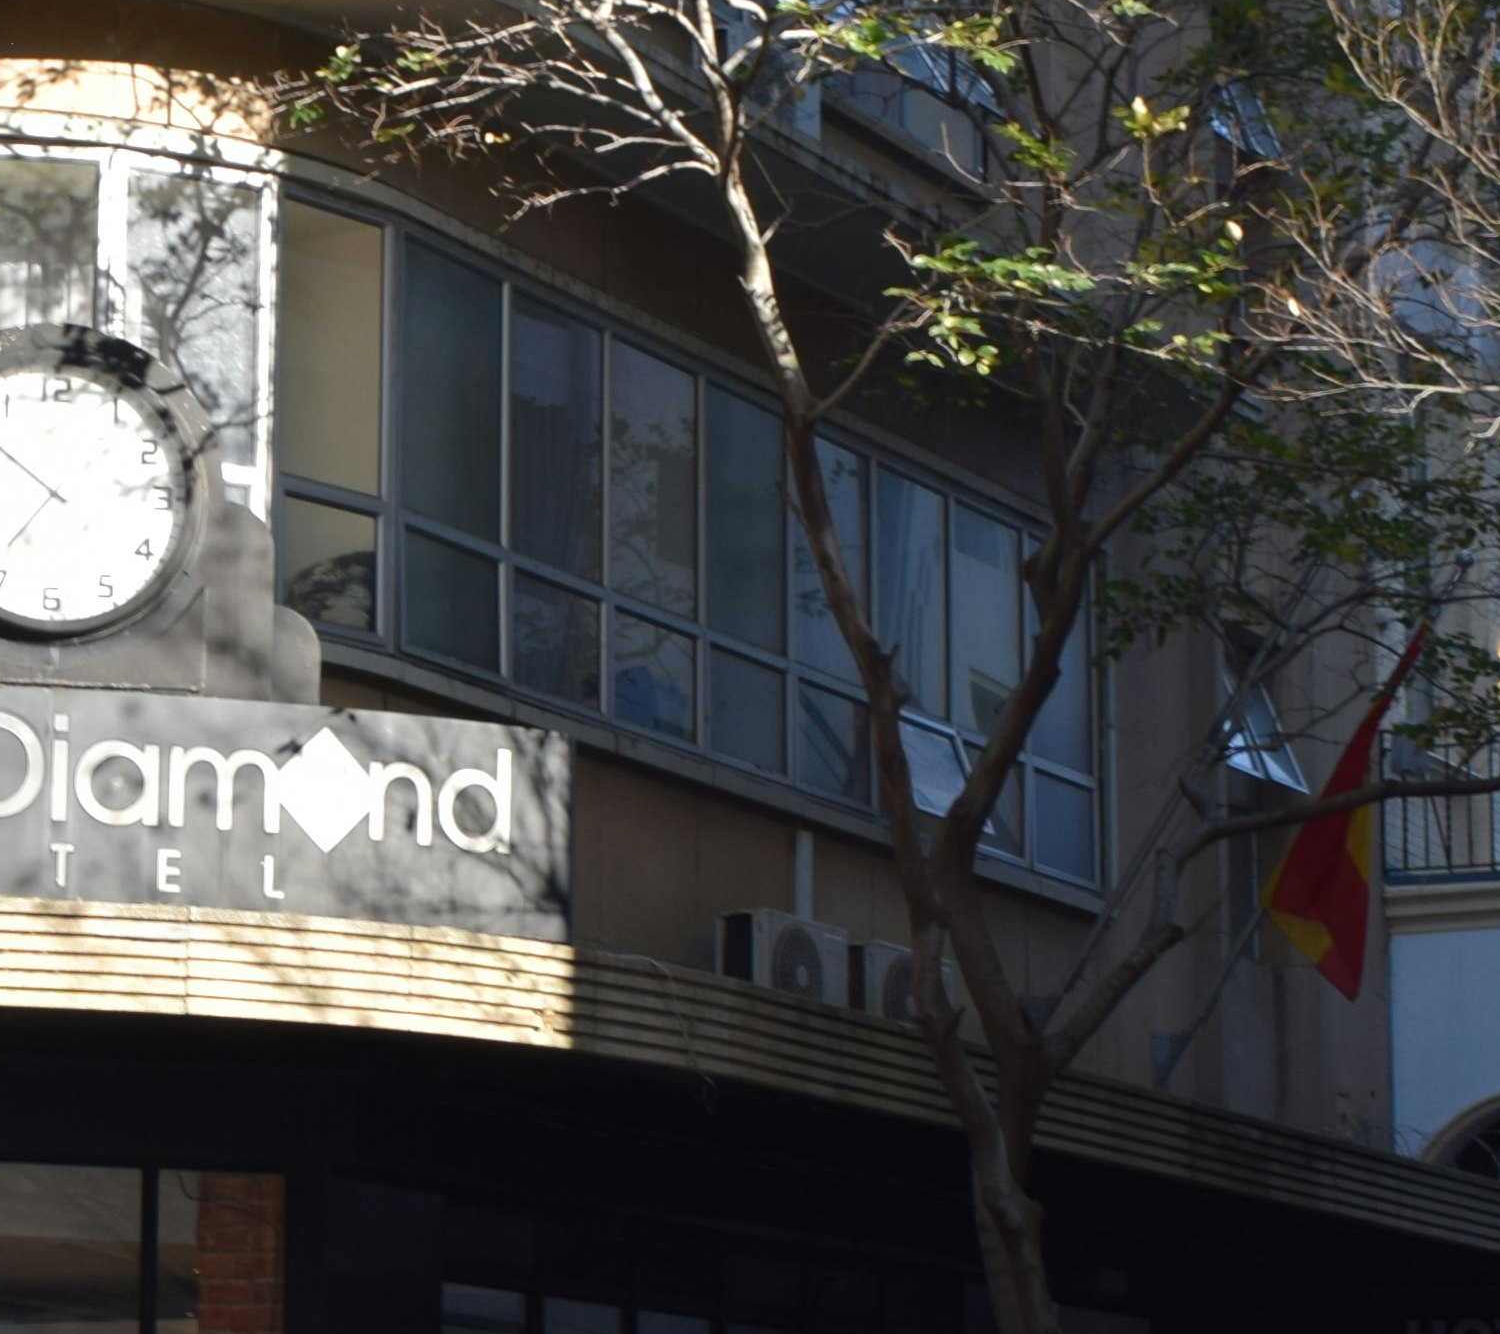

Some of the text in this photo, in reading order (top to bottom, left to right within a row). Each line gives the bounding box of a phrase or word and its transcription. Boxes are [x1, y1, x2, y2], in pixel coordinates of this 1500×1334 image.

[41, 376, 72, 402] 12
[113, 396, 119, 424] 1
[141, 440, 158, 464] 2
[153, 486, 172, 511] 3
[134, 538, 154, 561] 4
[98, 574, 114, 598] 5
[42, 587, 61, 611] 6
